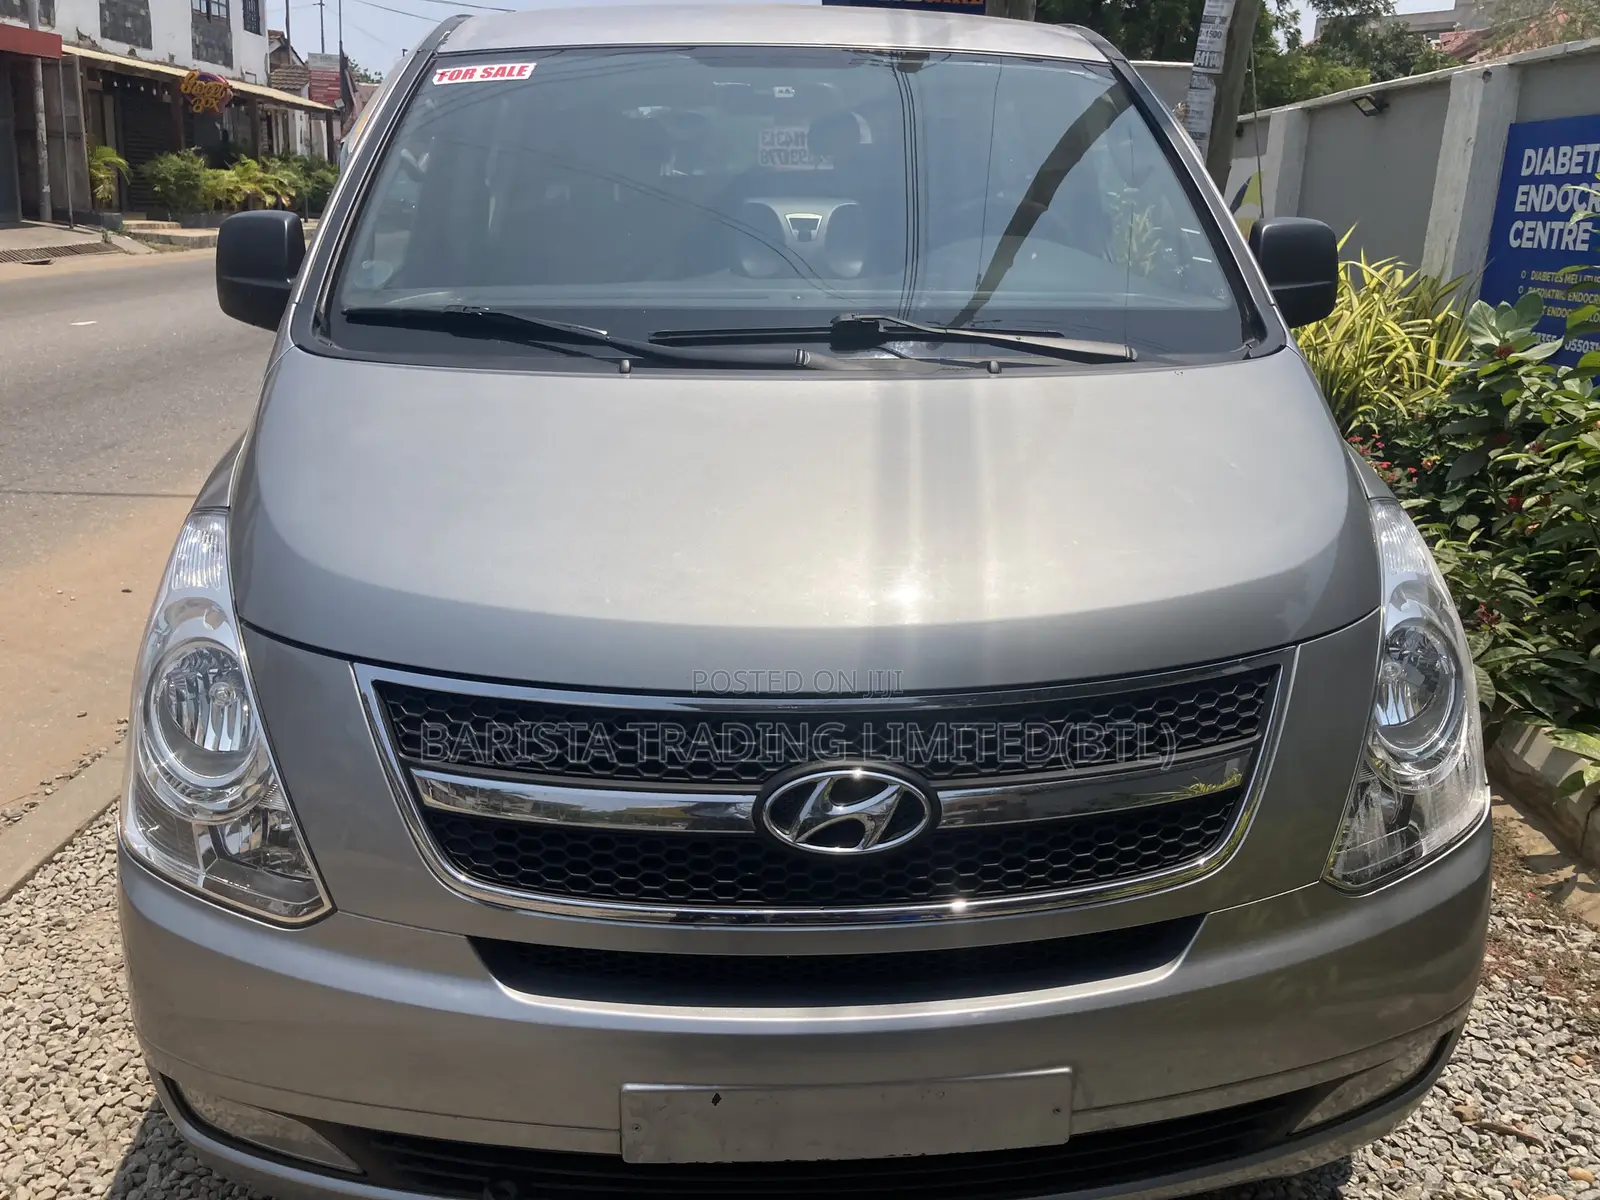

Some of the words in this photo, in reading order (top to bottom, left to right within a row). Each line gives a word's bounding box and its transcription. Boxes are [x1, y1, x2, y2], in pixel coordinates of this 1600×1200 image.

[436, 68, 477, 82] FOR
[480, 65, 530, 79] SALE
[1521, 143, 1600, 176] DIABET
[1509, 220, 1593, 251] CENTRE
